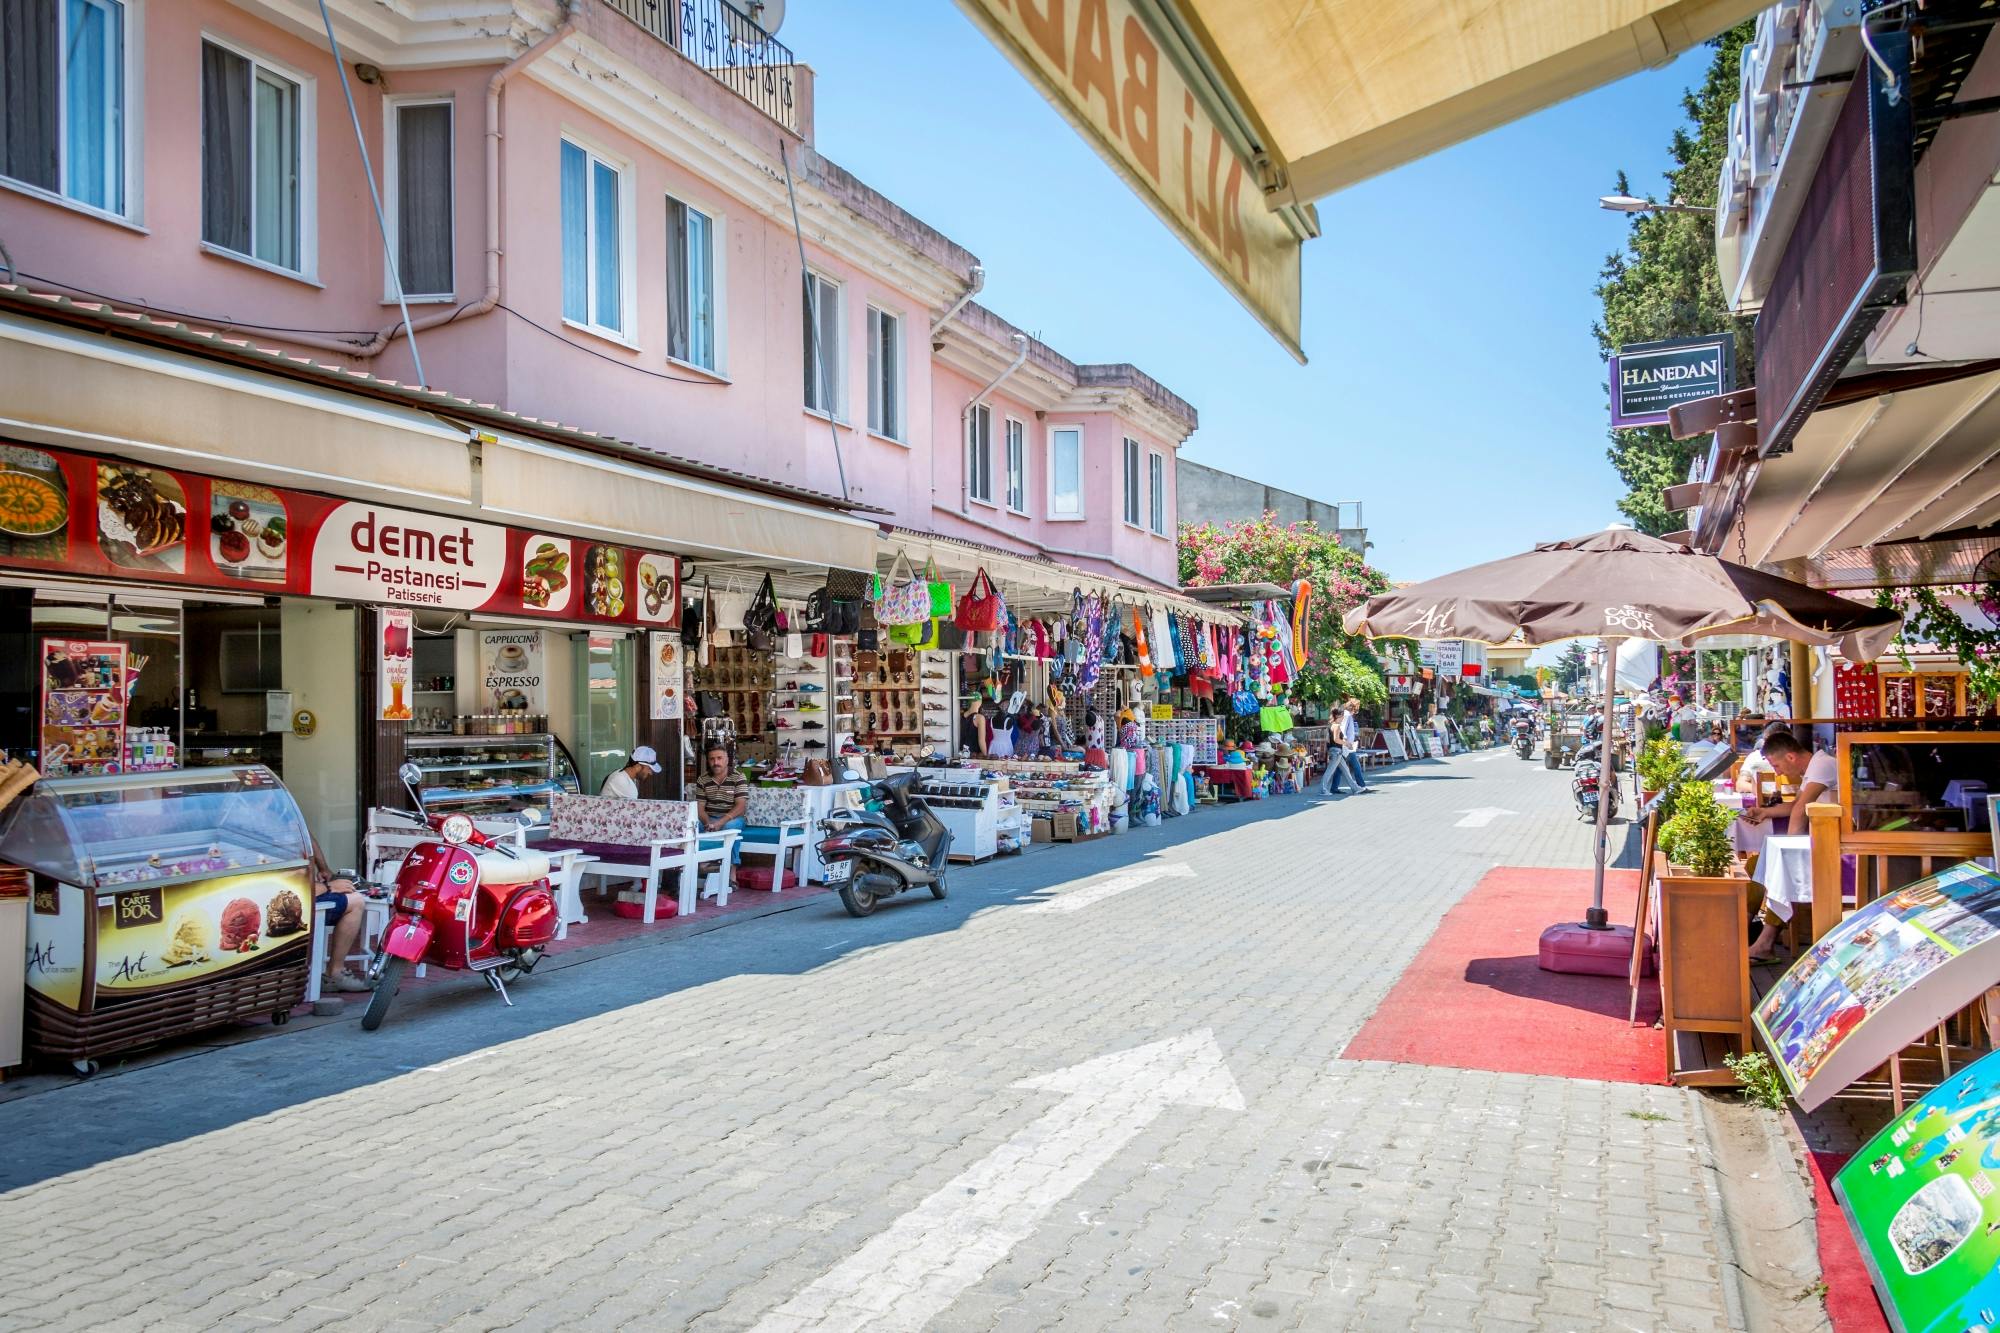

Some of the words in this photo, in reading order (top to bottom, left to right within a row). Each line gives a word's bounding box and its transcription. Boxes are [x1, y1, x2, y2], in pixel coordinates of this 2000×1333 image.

[1622, 360, 1718, 386] HANEDAN
[1643, 394, 1668, 402] DINING
[1669, 389, 1715, 399] RESTAURANT
[351, 511, 474, 567] demet
[367, 560, 460, 591] Pastanesi
[387, 587, 442, 604] Patisserie
[1403, 603, 1457, 635] Art
[1604, 607, 1653, 621] CARTE
[1605, 615, 1666, 641] D'OR
[484, 634, 539, 644] CAPPUCCINO
[485, 676, 540, 688] ESPRESSO
[121, 895, 151, 907] CARTE
[122, 904, 159, 919] D'OR
[27, 940, 56, 974] Art
[109, 951, 149, 985] Art
